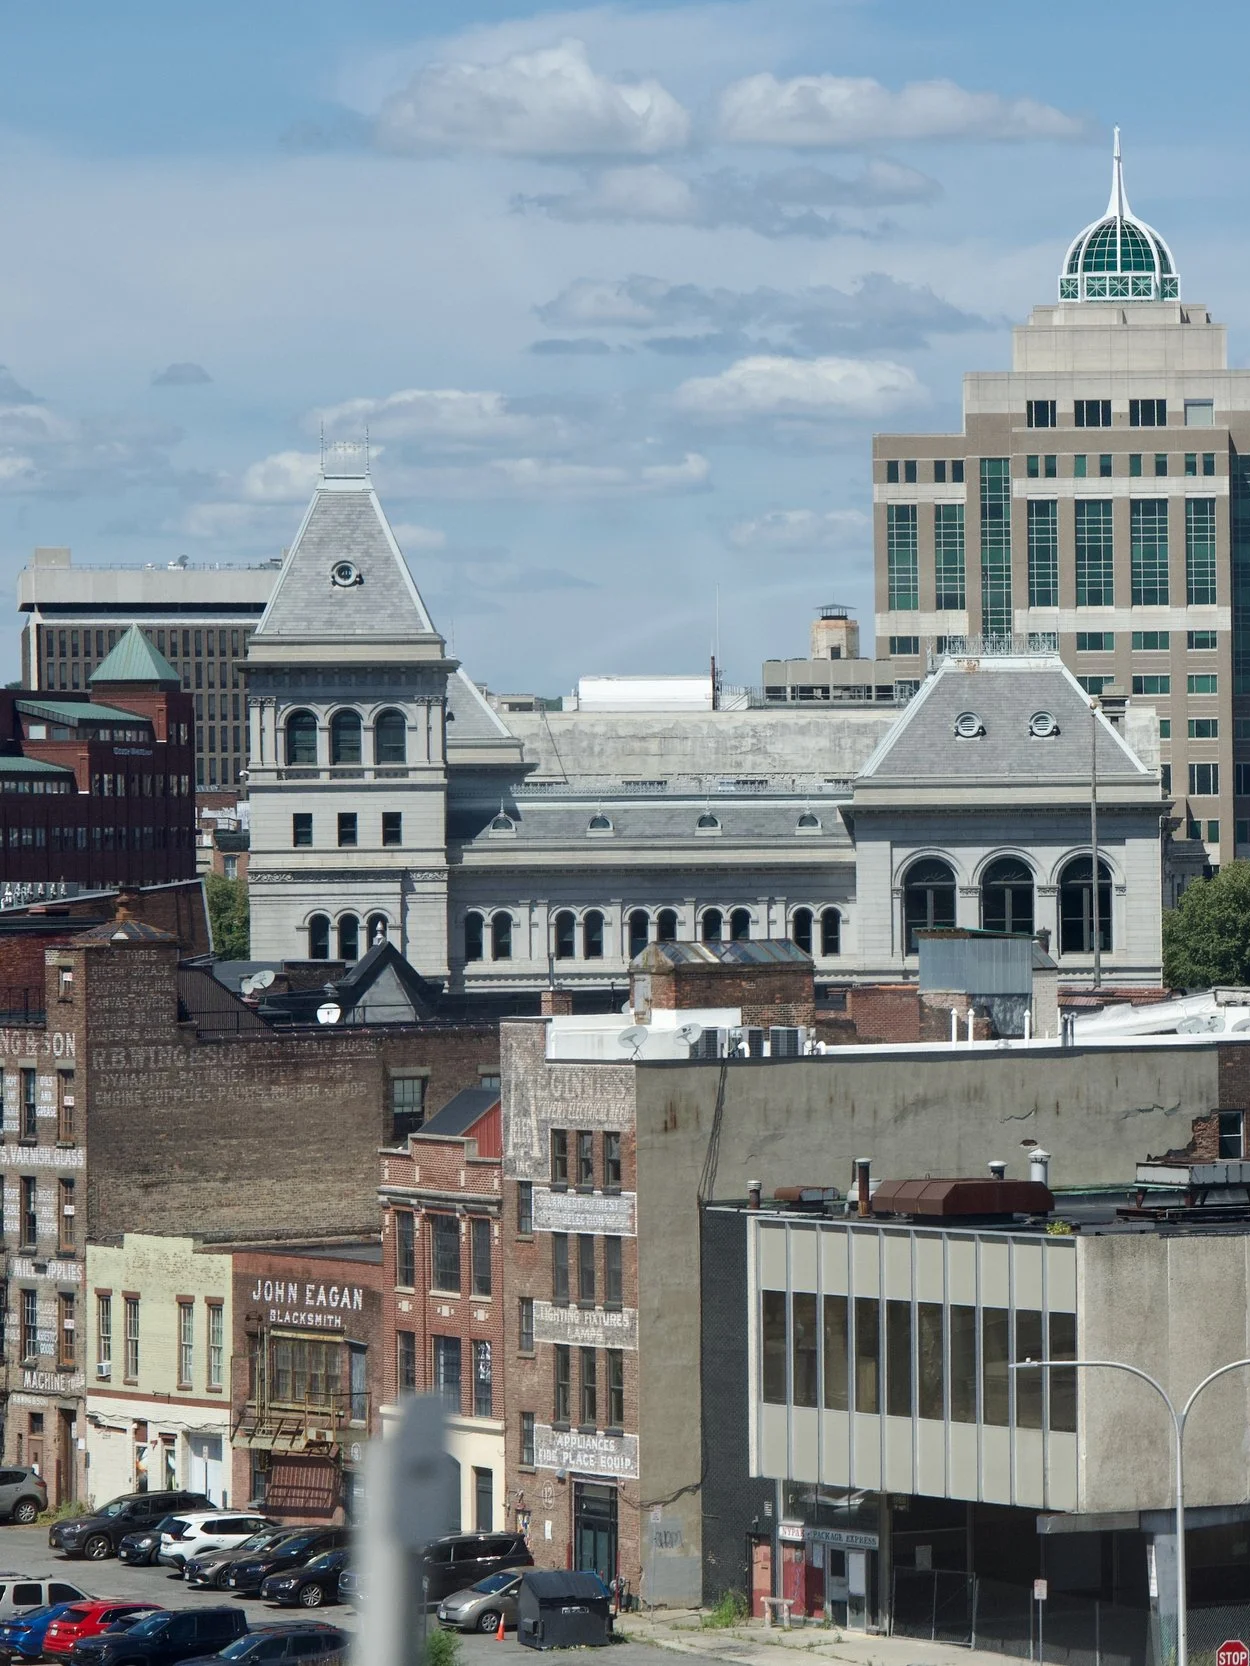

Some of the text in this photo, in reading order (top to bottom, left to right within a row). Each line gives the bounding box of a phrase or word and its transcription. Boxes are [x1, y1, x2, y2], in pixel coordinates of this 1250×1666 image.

[26, 1031, 38, 1056] &
[41, 1032, 76, 1057] SON
[253, 1279, 363, 1311] JOHN EAGAN
[269, 1308, 342, 1328] BLACKSMITH
[540, 1306, 630, 1328] LIGHTING FIXTURES
[23, 1371, 65, 1391] MACHINE
[556, 1435, 616, 1452] APPLIANCES
[562, 1451, 596, 1467] PLACE
[600, 1456, 634, 1471] EQUIP.
[813, 1531, 843, 1542] PACKAGE
[846, 1535, 877, 1545] EXPRESS
[1219, 1651, 1247, 1666] STOP
